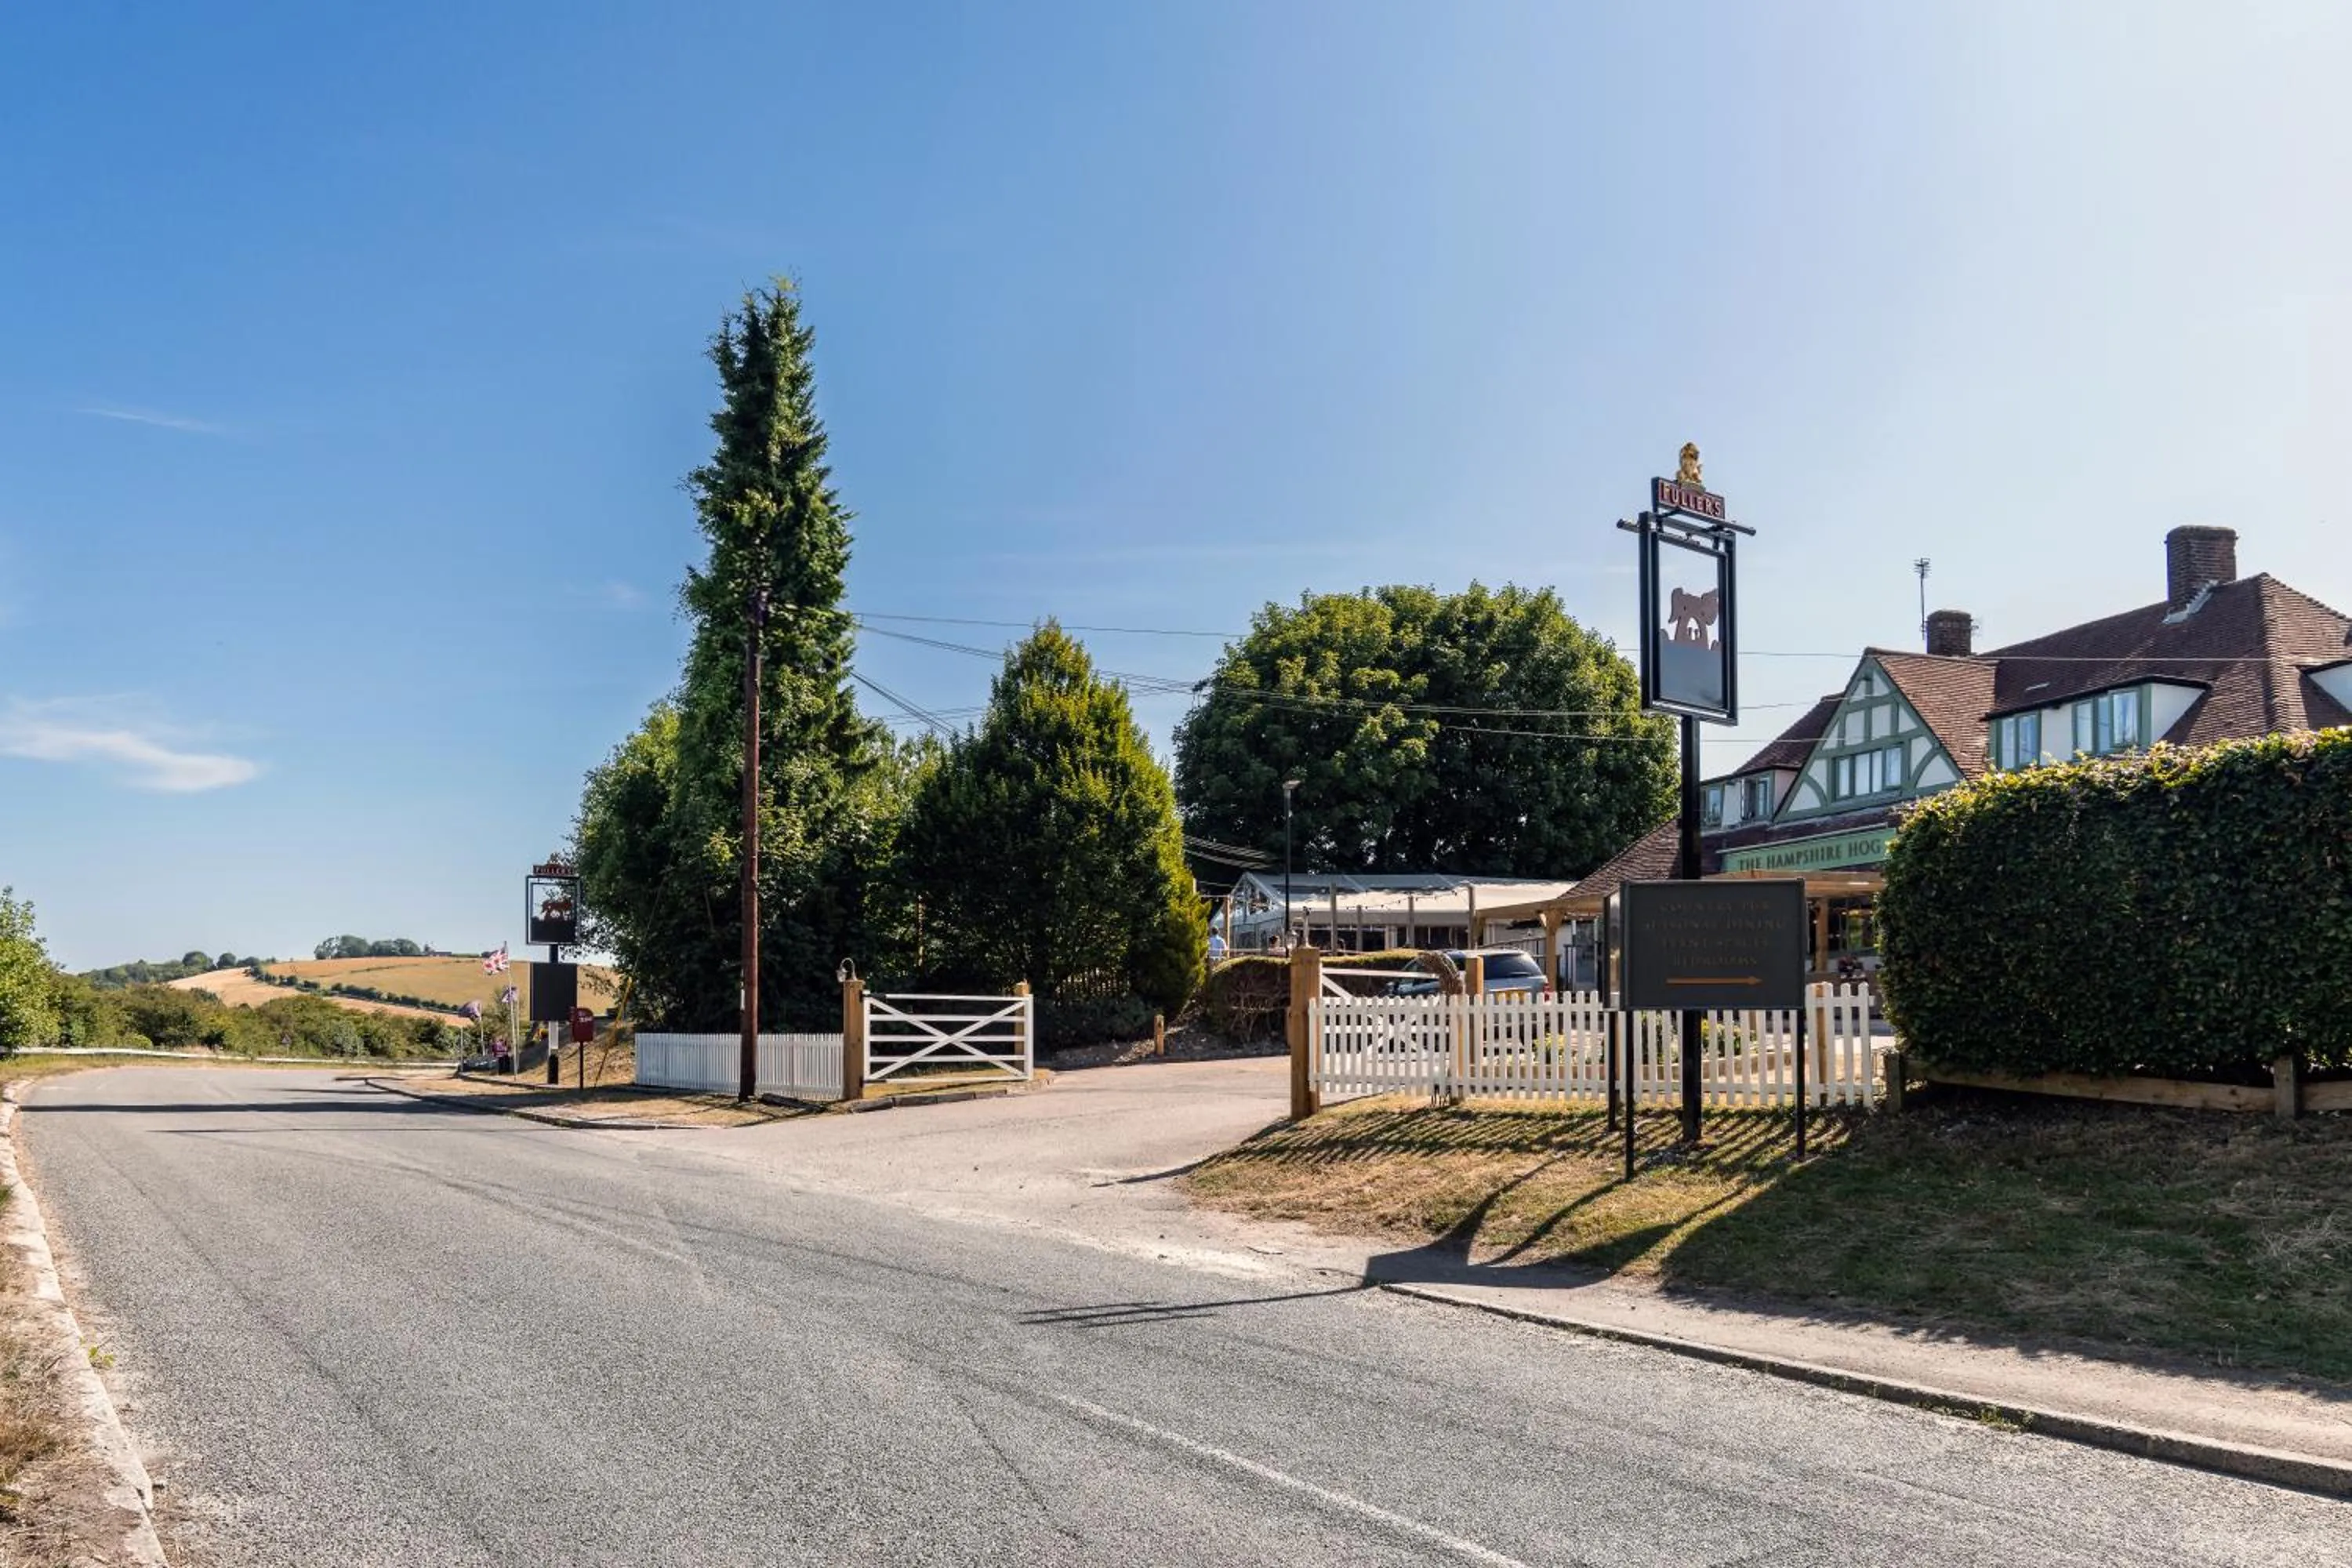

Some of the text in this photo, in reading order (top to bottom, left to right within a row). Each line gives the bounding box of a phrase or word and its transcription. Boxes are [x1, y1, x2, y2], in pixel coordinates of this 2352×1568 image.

[1739, 839, 1881, 872] THE HAMPSHIRE HOG
